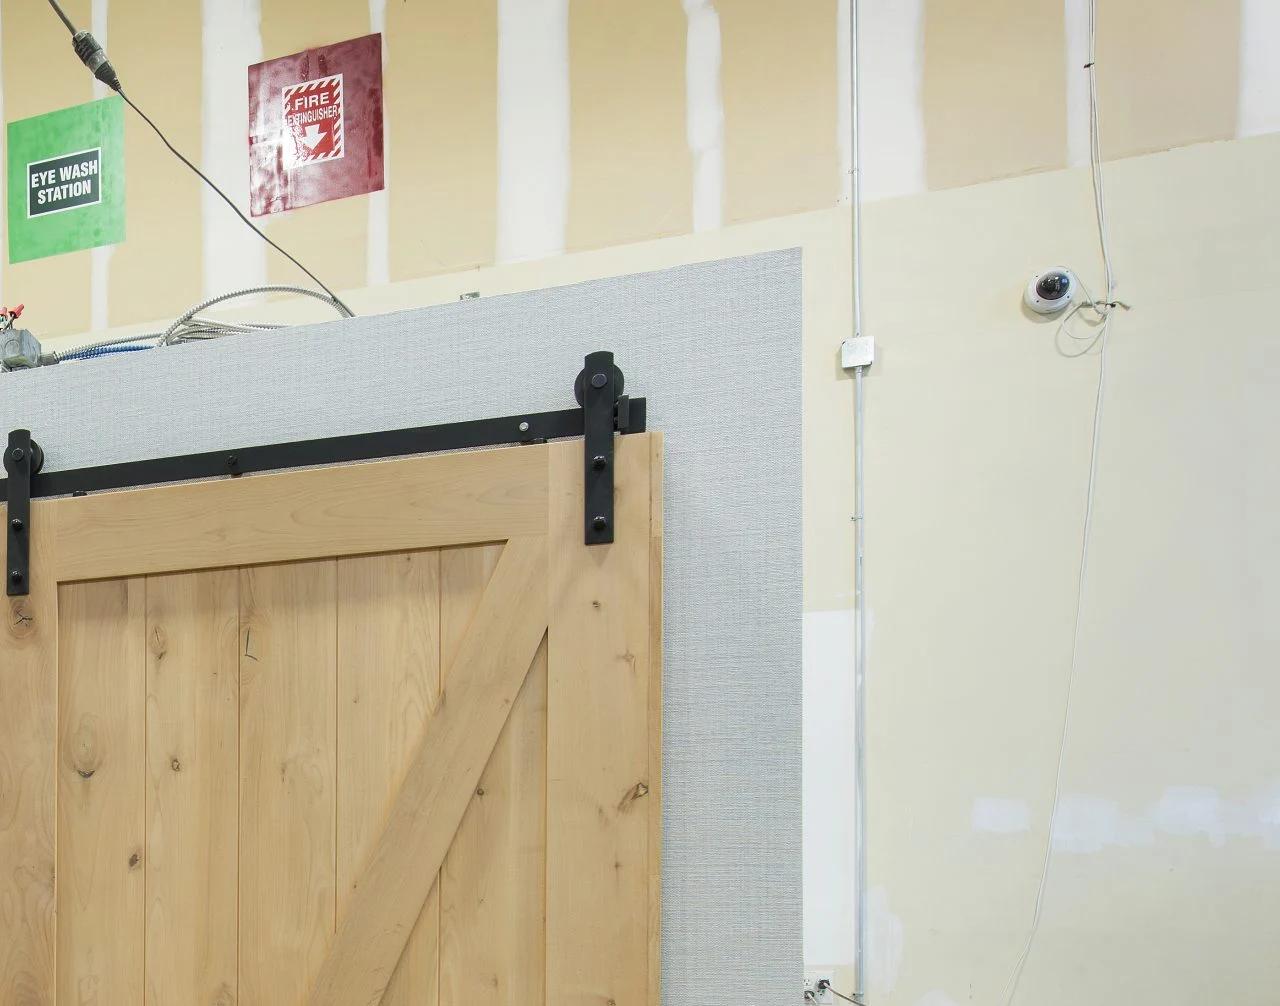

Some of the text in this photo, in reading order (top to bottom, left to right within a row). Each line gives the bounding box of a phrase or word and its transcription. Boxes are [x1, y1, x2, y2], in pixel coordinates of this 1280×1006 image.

[295, 92, 330, 111] FIRE
[287, 105, 338, 126] EXTINGUISHER
[31, 160, 98, 189] EYE WASH
[37, 179, 92, 205] STATION
